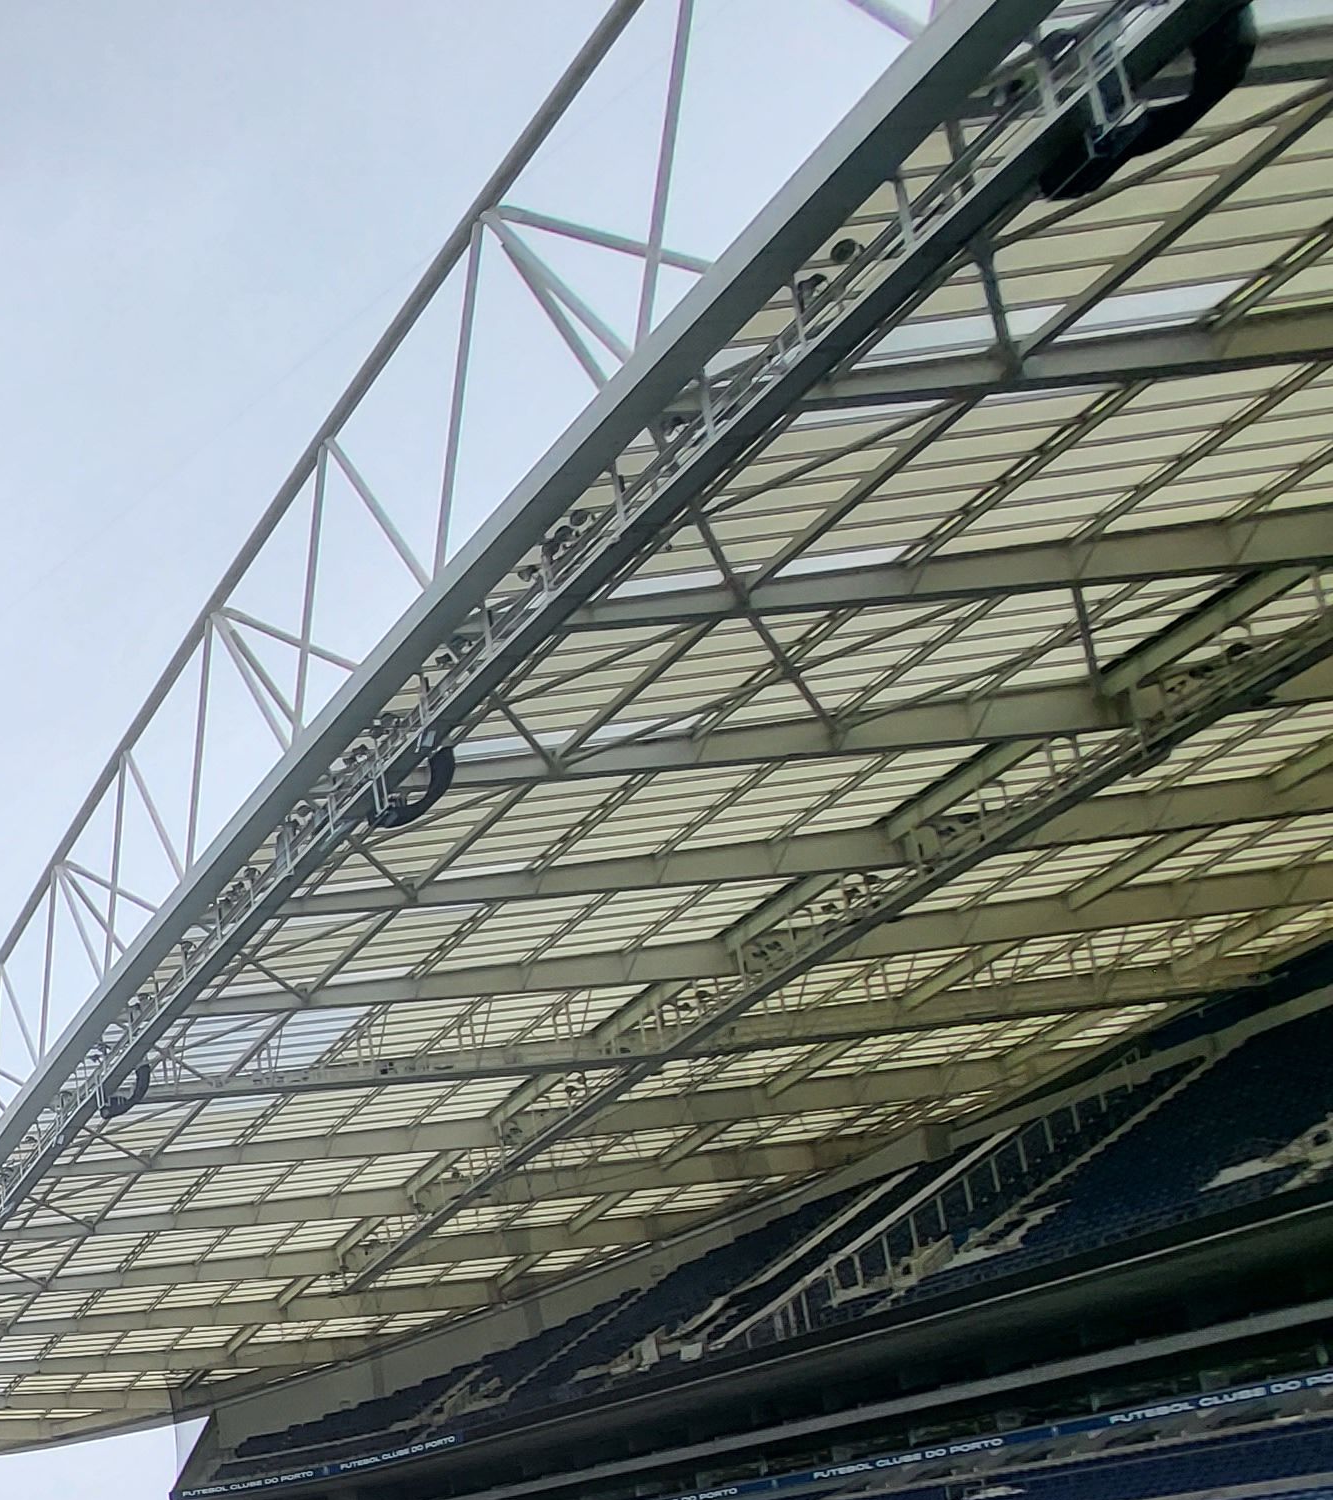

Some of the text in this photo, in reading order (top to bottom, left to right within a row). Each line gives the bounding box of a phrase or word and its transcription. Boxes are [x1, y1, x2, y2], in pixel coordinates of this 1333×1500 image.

[1109, 1401, 1196, 1424] FUTEBOL
[1198, 1387, 1267, 1407] CLUBE
[1270, 1381, 1301, 1393] DO
[339, 1435, 455, 1470] FUTEBOL CLUBE DO PORTO
[813, 1438, 1004, 1479] FUTEBOL CLUBE DO PORTO
[182, 1470, 314, 1497] FUTEBOL CLUBE DO PORTO
[699, 1487, 738, 1500] PORTO
